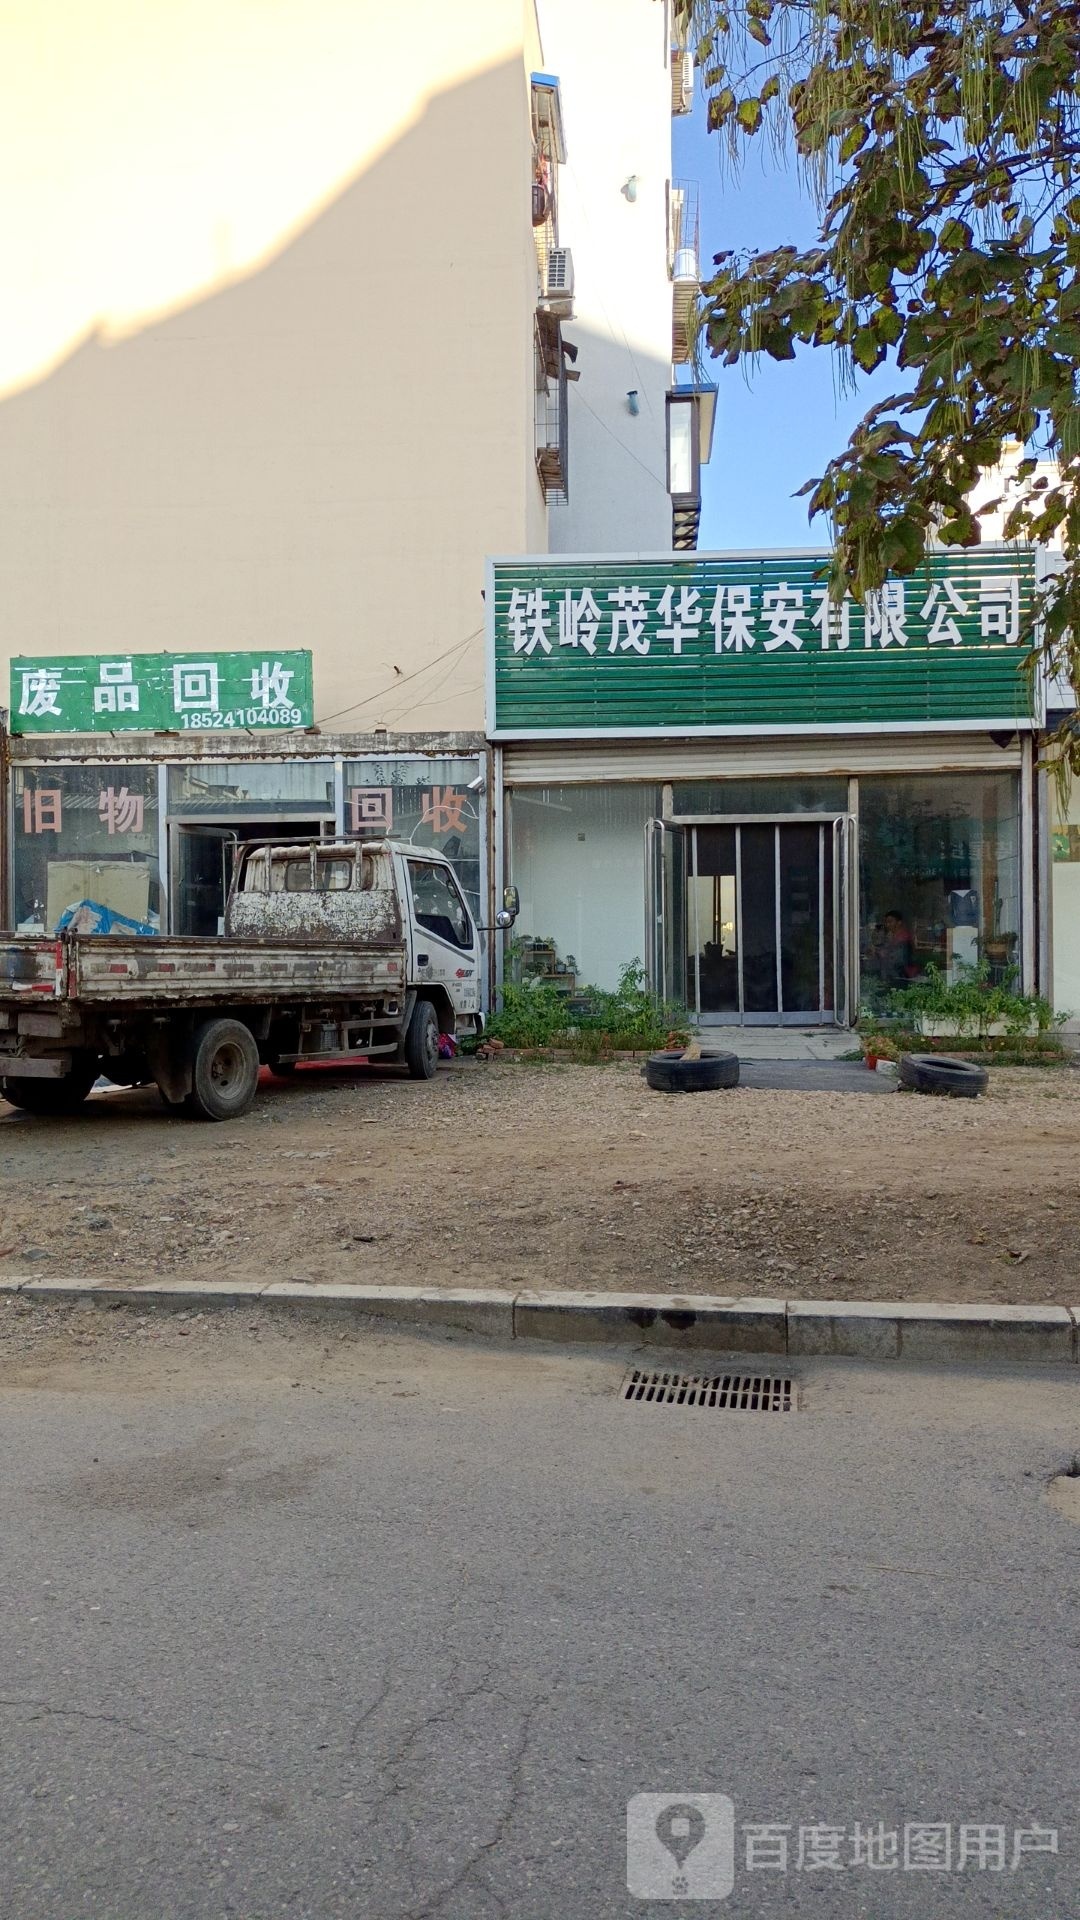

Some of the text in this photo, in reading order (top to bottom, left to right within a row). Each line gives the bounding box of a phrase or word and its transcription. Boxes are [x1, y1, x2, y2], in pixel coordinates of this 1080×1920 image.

[507, 578, 1020, 656] 铁岭茂华保安有限公司
[18, 661, 295, 716] 废品回收
[180, 708, 301, 729] 18524104089
[23, 786, 468, 834] 旧物 回收
